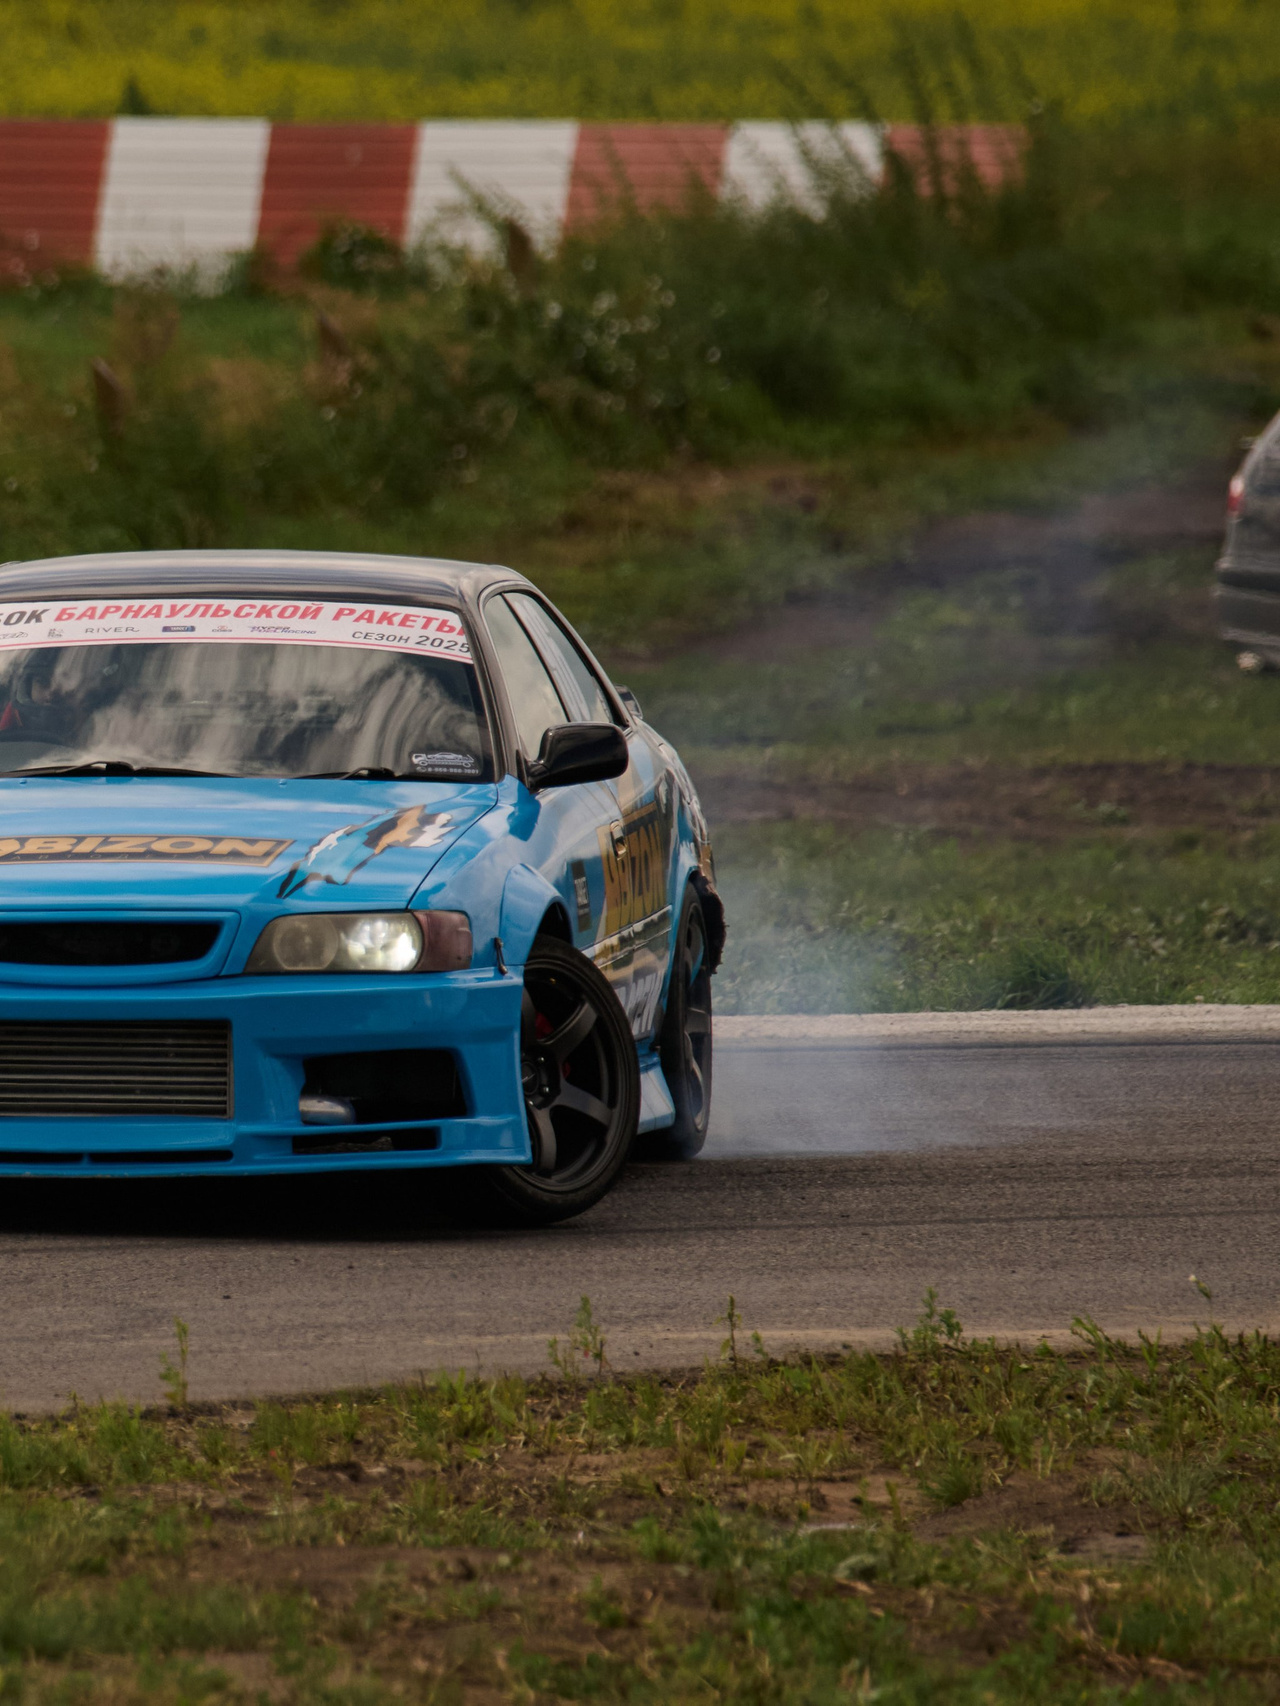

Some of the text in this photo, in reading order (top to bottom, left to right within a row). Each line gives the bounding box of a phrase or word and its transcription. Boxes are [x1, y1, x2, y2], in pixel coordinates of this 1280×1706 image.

[53, 603, 324, 622] БАРНАУЛЬСКОЙ
[331, 607, 466, 636] РАКЕТЫ
[84, 626, 140, 634] RIVER
[351, 630, 470, 654] СЕЗОН 2025
[14, 836, 278, 857] BIZON
